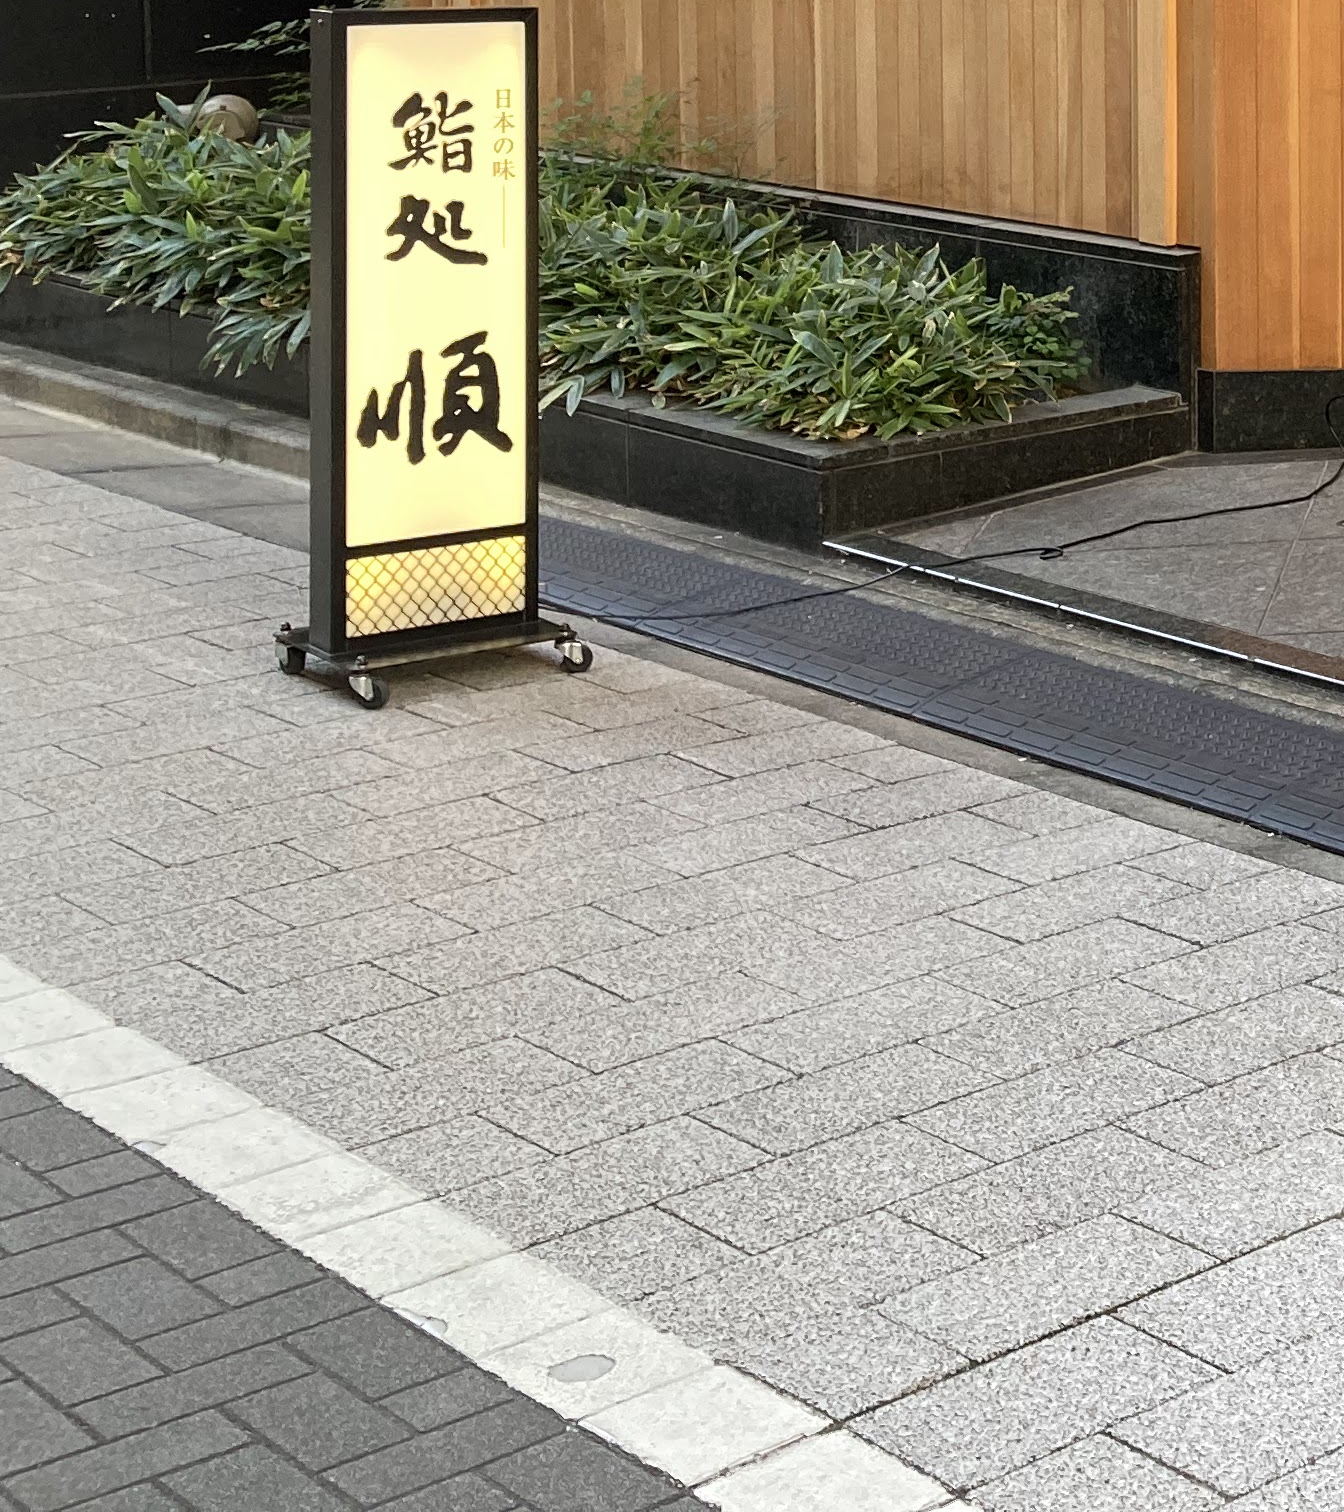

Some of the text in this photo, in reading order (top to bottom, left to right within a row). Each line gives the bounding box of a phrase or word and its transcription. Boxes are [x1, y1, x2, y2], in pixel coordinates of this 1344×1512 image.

[492, 88, 516, 181] 日本の味
[356, 91, 513, 466] 鮨処順
